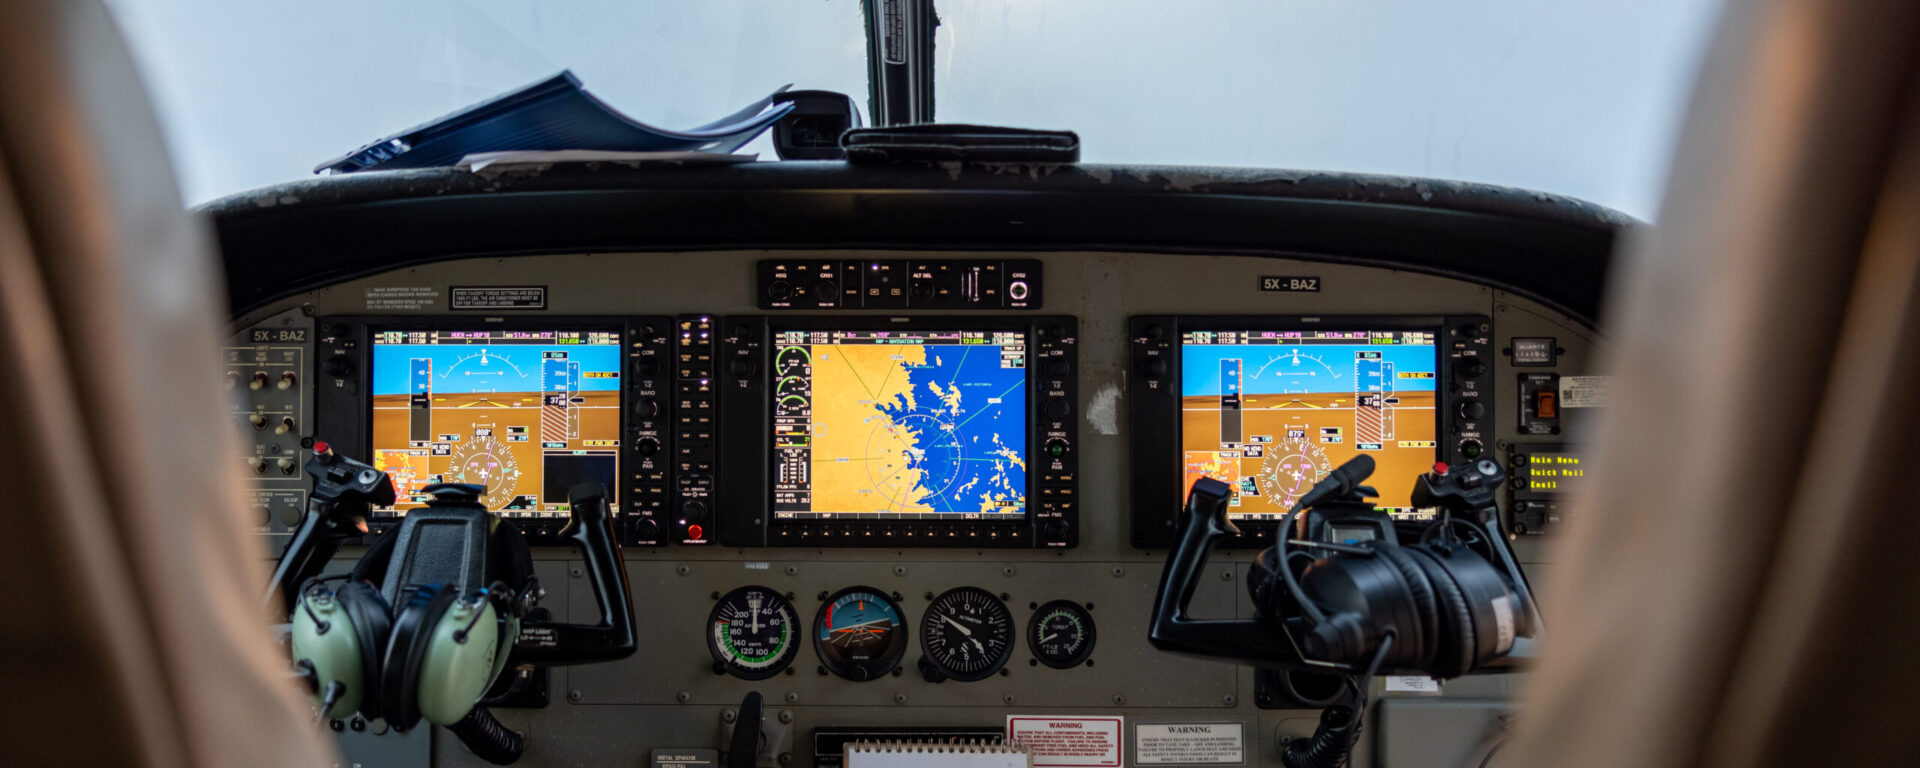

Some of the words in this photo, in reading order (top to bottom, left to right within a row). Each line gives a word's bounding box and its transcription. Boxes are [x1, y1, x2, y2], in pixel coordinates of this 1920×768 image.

[1264, 279, 1280, 289] 5X
[1290, 279, 1317, 290] BAZ
[254, 331, 269, 341] 5X
[280, 331, 304, 342] BAZ
[1530, 456, 1551, 464] Main
[1557, 456, 1579, 464] Menu
[731, 619, 744, 627] 180
[959, 615, 982, 625] ALTIMETER
[733, 639, 746, 647] 140
[741, 647, 754, 655] 120
[756, 647, 769, 655] 100
[1168, 726, 1211, 734] WARNING
